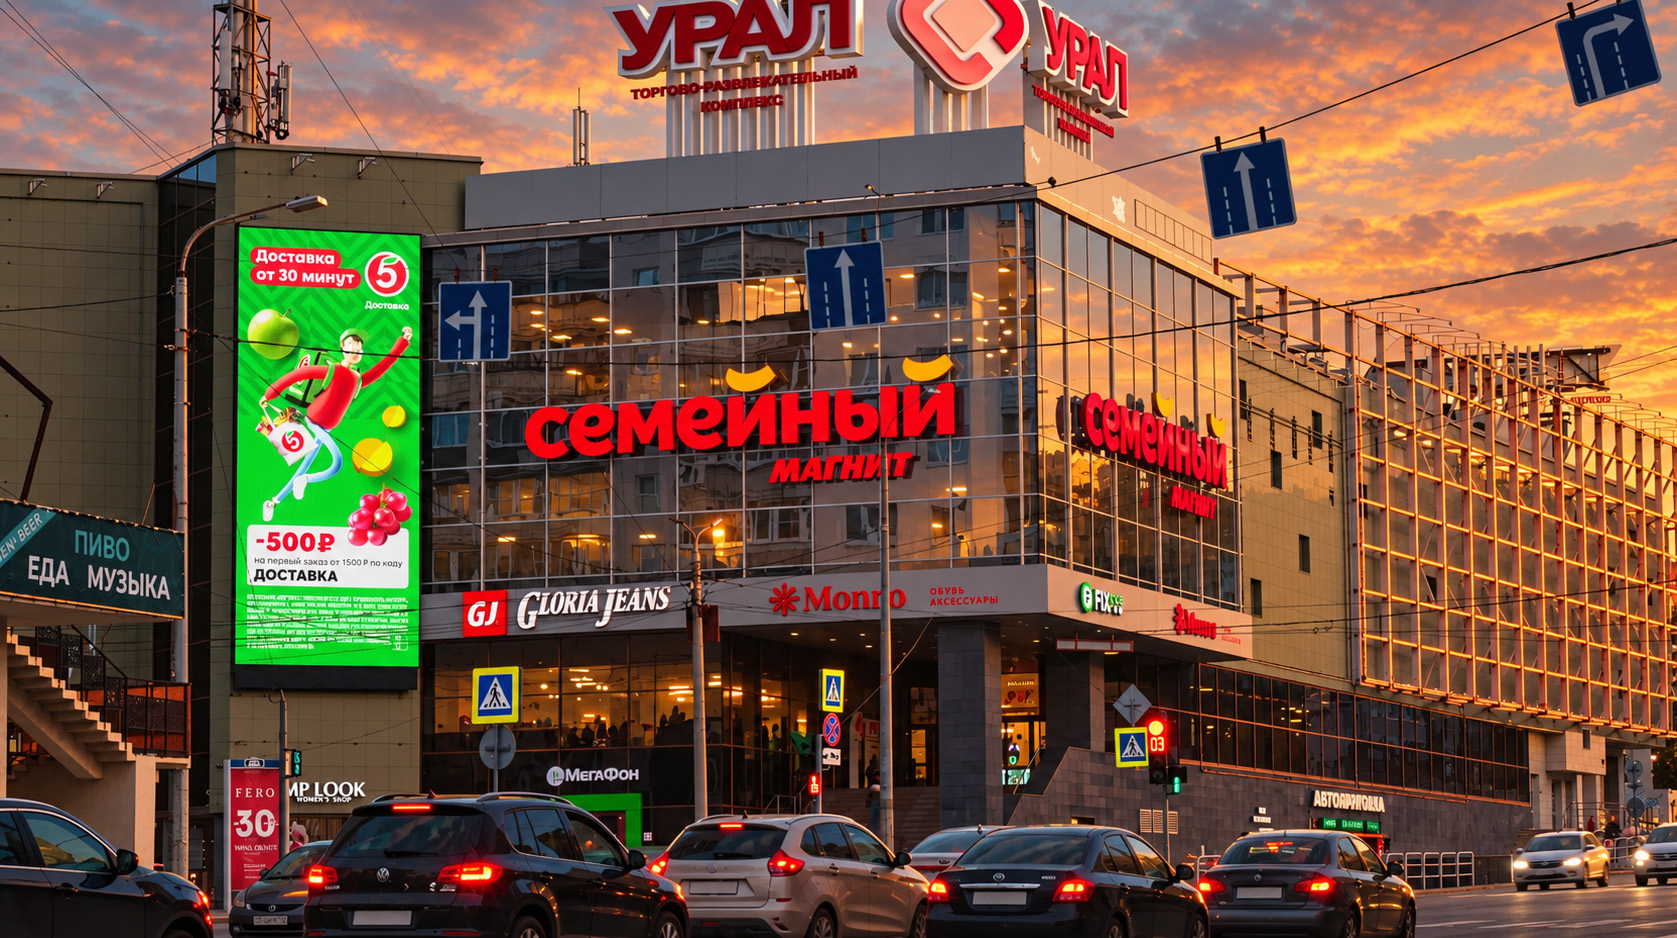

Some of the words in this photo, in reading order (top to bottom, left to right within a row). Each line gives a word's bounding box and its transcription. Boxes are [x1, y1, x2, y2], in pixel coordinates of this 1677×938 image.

[611, 0, 851, 70] УРАЛ
[1041, 5, 1128, 111] УРАЛ
[700, 94, 784, 113] КОМПЛЕКС
[255, 249, 335, 264] Доставка
[256, 270, 275, 281] от
[278, 270, 298, 282] 30
[302, 272, 355, 287] минут
[364, 300, 409, 310] Доставка
[768, 451, 913, 483] МАГНИТ
[1169, 485, 1217, 519] МАГНИТ
[17, 512, 43, 542] BEER
[74, 529, 130, 562] ПИВО
[342, 558, 362, 567] 1500
[382, 560, 403, 569] коду
[28, 554, 70, 588] ЕДА
[87, 564, 171, 600] МУЗЫКА
[253, 568, 338, 582] ДОСТАВКА
[803, 586, 907, 612] Monro
[929, 586, 965, 596] ОБУВЬ
[929, 595, 999, 607] АКСЕССУАРЫ
[467, 600, 499, 627] GJ
[1150, 736, 1165, 752] 03
[235, 787, 275, 798] FERO
[314, 781, 366, 797] LOOK
